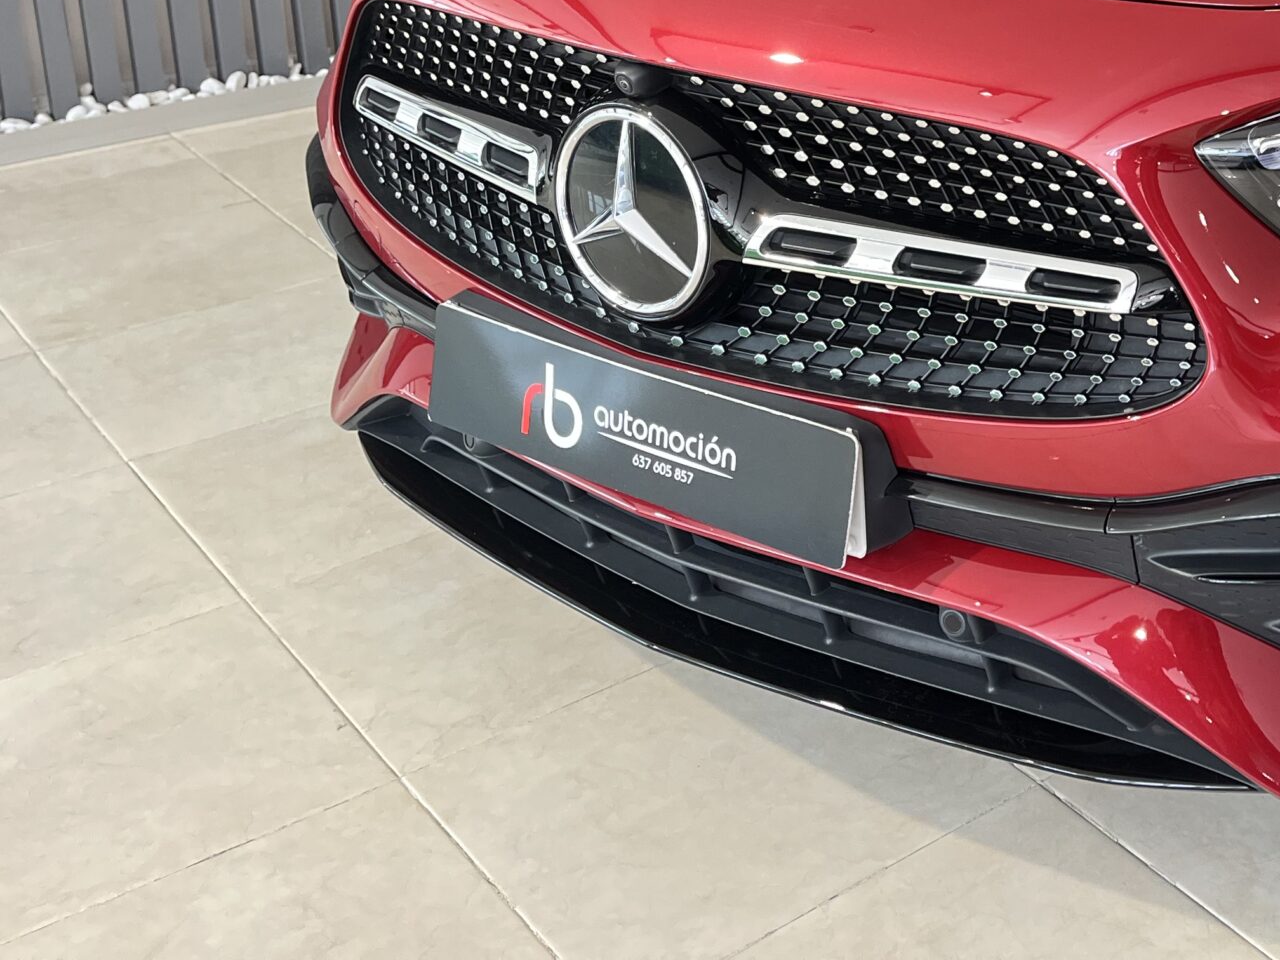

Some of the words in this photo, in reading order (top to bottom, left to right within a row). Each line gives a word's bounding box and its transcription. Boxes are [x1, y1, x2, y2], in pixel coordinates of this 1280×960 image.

[593, 405, 737, 472] automoción
[632, 453, 652, 470] 637
[652, 460, 673, 478] 605
[673, 467, 694, 485] 857
